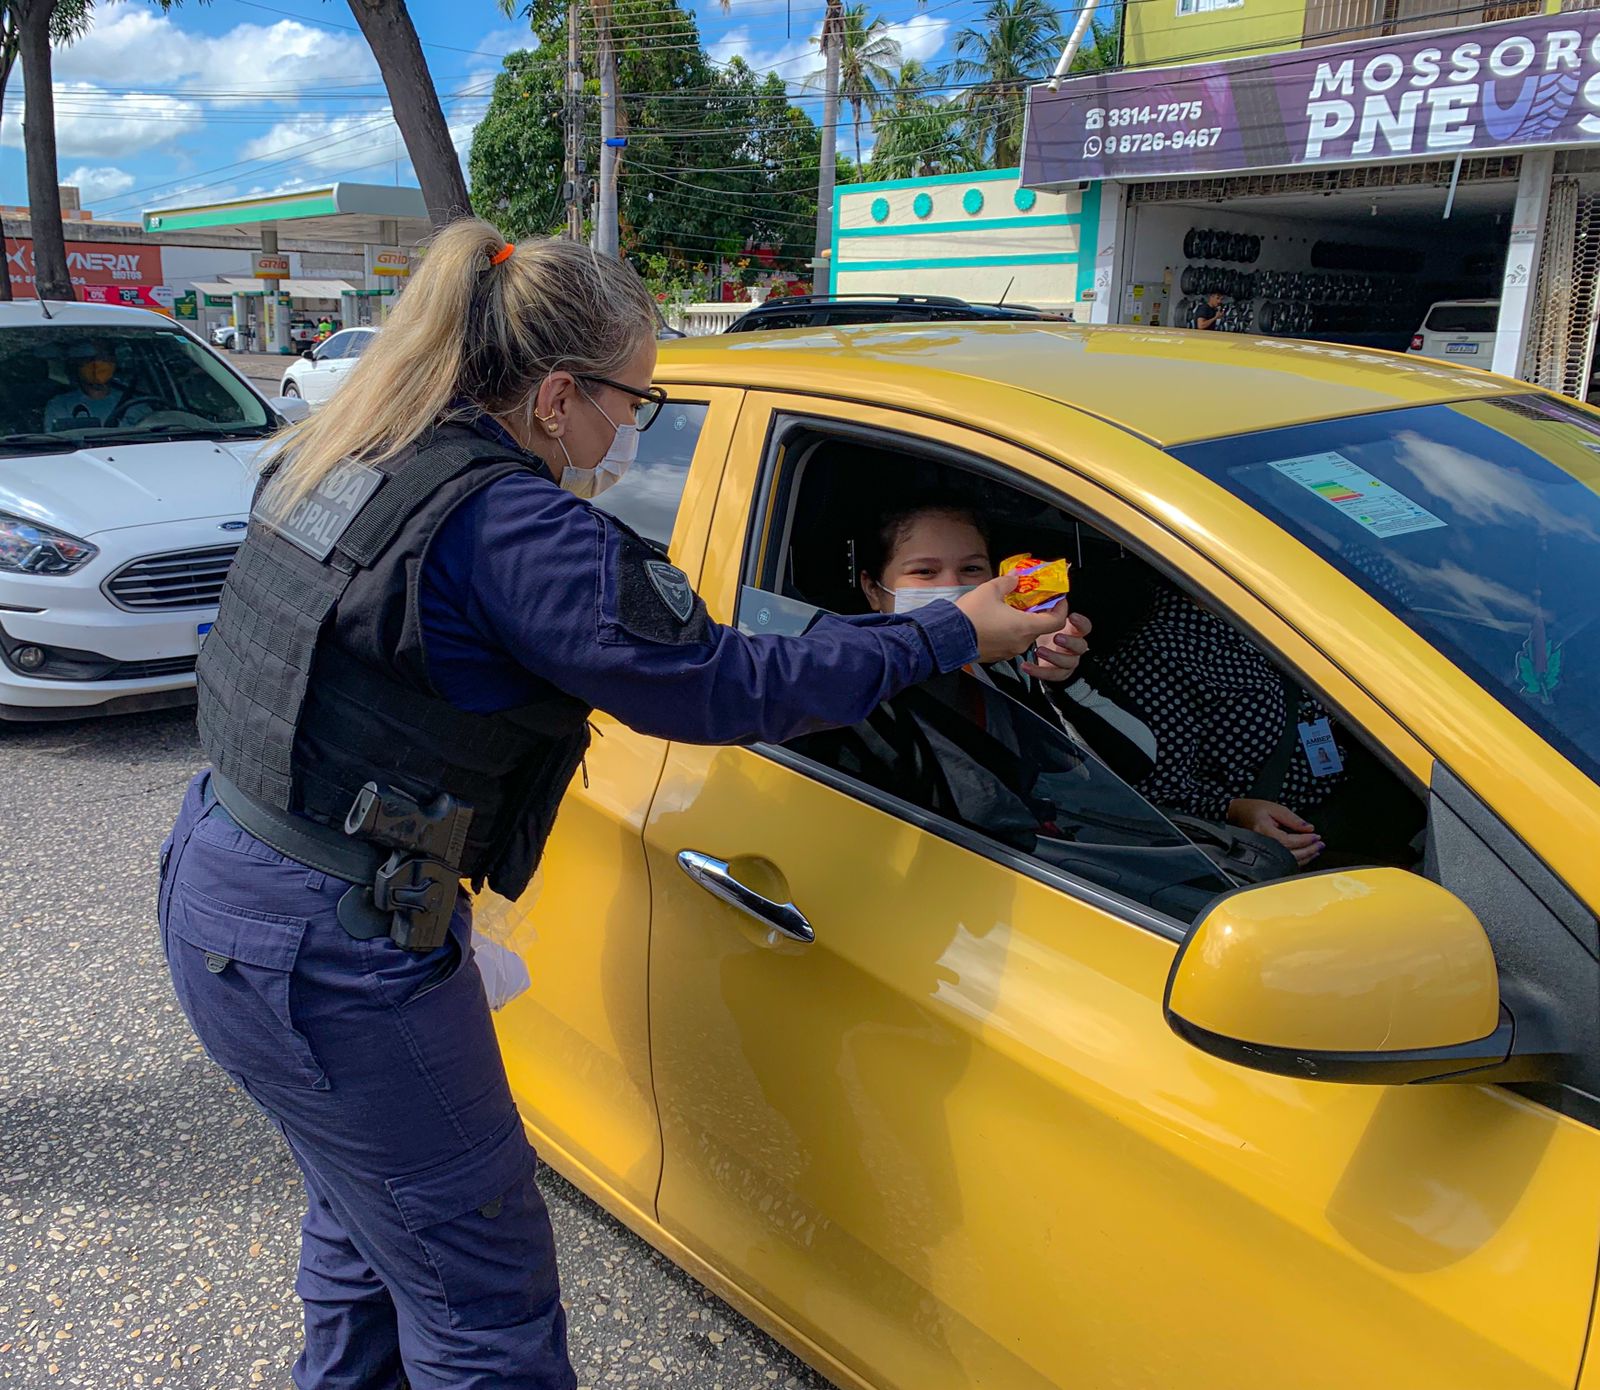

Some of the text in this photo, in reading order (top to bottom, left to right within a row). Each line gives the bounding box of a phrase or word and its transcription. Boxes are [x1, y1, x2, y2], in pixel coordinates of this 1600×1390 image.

[1309, 30, 1600, 99] MOSSOR
[1108, 101, 1203, 127] 3314-7275
[1119, 127, 1222, 153] 8726-9467
[112, 270, 142, 280] MOTOS
[258, 260, 288, 269] GRID
